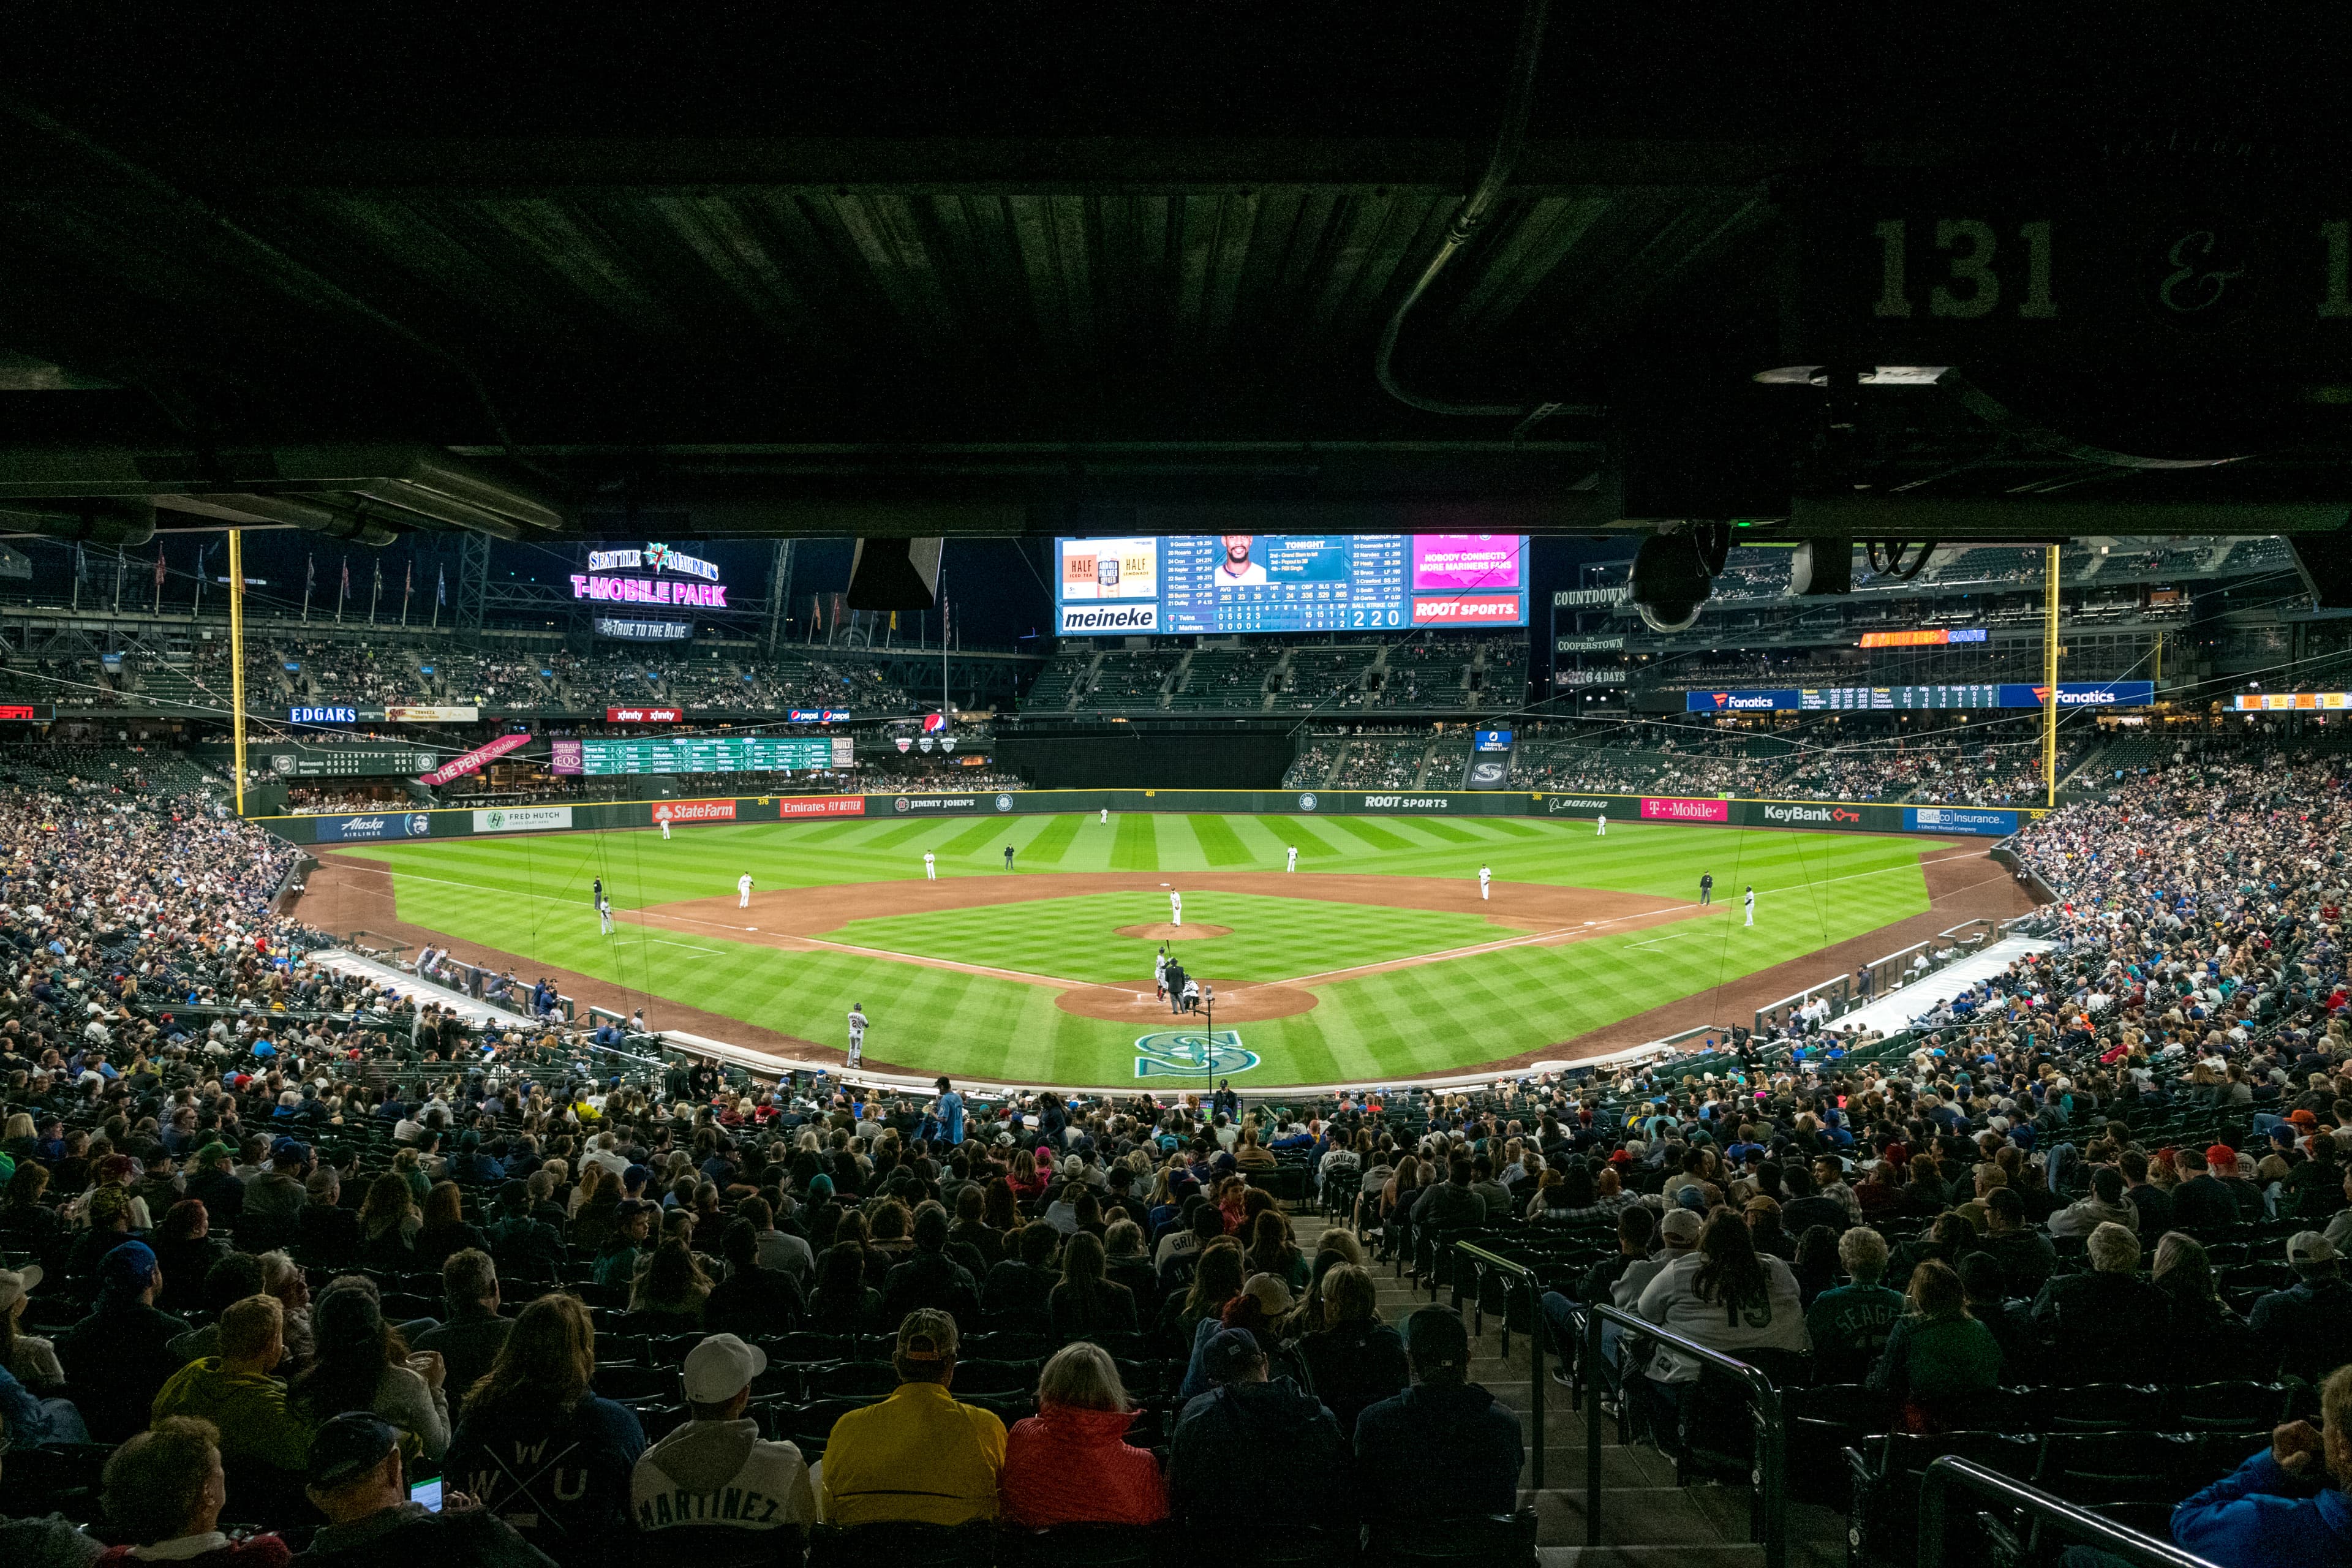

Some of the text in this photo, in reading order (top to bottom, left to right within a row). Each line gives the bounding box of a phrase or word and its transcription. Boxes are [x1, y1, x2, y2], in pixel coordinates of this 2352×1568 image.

[1872, 219, 2245, 319] 131 &
[589, 550, 641, 571] SEATTLE
[1425, 552, 1507, 562] NOBODY CONNECTS
[668, 551, 718, 581] MARINERS
[1072, 560, 1091, 573] HALF
[1126, 559, 1145, 570] HALF
[1420, 560, 1512, 571] MORE MARINERS FANS
[570, 575, 727, 607] T-MOBILE PARK
[1555, 587, 1627, 606] COUNTDOWN
[1416, 602, 1460, 616] ROOT
[1065, 608, 1153, 628] meineke
[1354, 610, 1399, 627] 2 2 0
[612, 620, 687, 638] TRUE TO THE BLUE
[1948, 629, 1986, 642] CAFE
[1558, 638, 1623, 650] COOPERSTOWN
[1604, 671, 1626, 682] DAYS
[1728, 696, 1773, 707] Fanatics
[2054, 690, 2115, 703] Fanatics
[0, 706, 33, 718] SPN
[292, 707, 356, 722] EDGAR'S
[617, 710, 674, 721] xfinity xfinity
[834, 741, 851, 749] BUILT
[556, 755, 579, 766] EQC
[434, 763, 458, 783] THE
[455, 754, 481, 772] 'PEN
[784, 801, 861, 813] Emirates FLY BETTER
[911, 799, 975, 809] JIMMY JOHN'S
[1365, 796, 1447, 808] ROOT SPORTS
[1765, 805, 1831, 823] KeyBank
[1920, 810, 2000, 824] Safeco Insurance
[2030, 811, 2045, 820] 326
[341, 816, 385, 831] Alaska
[1331, 1151, 1357, 1164] TAYLOR
[514, 1436, 549, 1465] W
[553, 1468, 588, 1501] U
[640, 1489, 778, 1525] MARTINEZ
